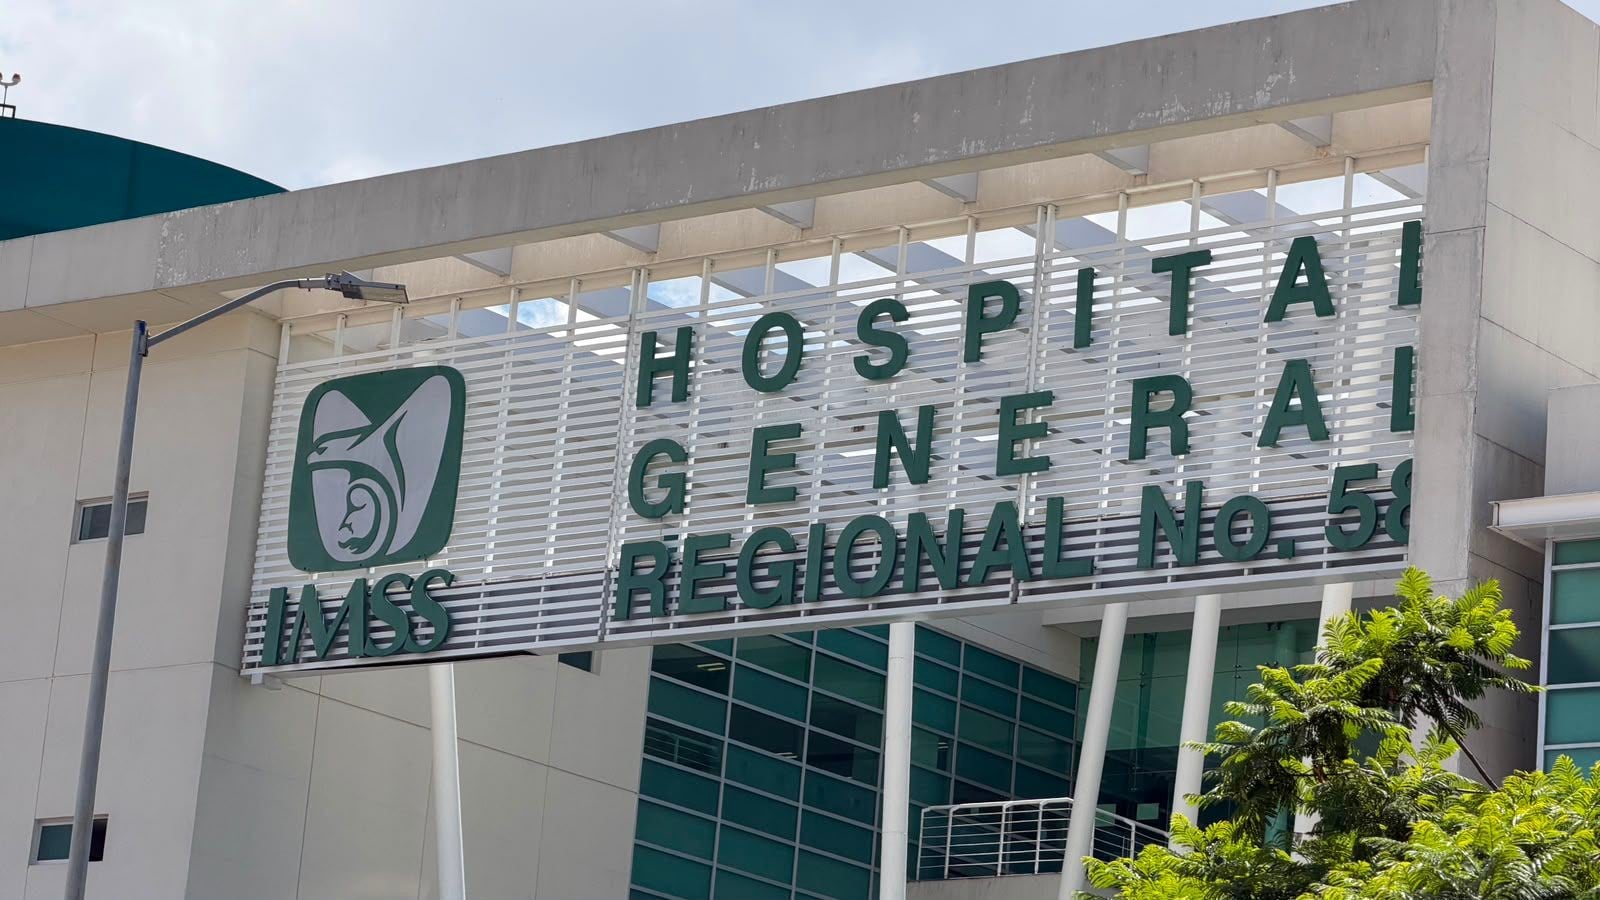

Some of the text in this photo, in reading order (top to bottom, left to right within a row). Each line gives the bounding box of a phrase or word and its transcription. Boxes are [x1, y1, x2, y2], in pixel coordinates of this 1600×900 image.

[614, 497, 1095, 621] REGIONAL
[1136, 480, 1296, 569] No.
[261, 568, 455, 666] IMSS
